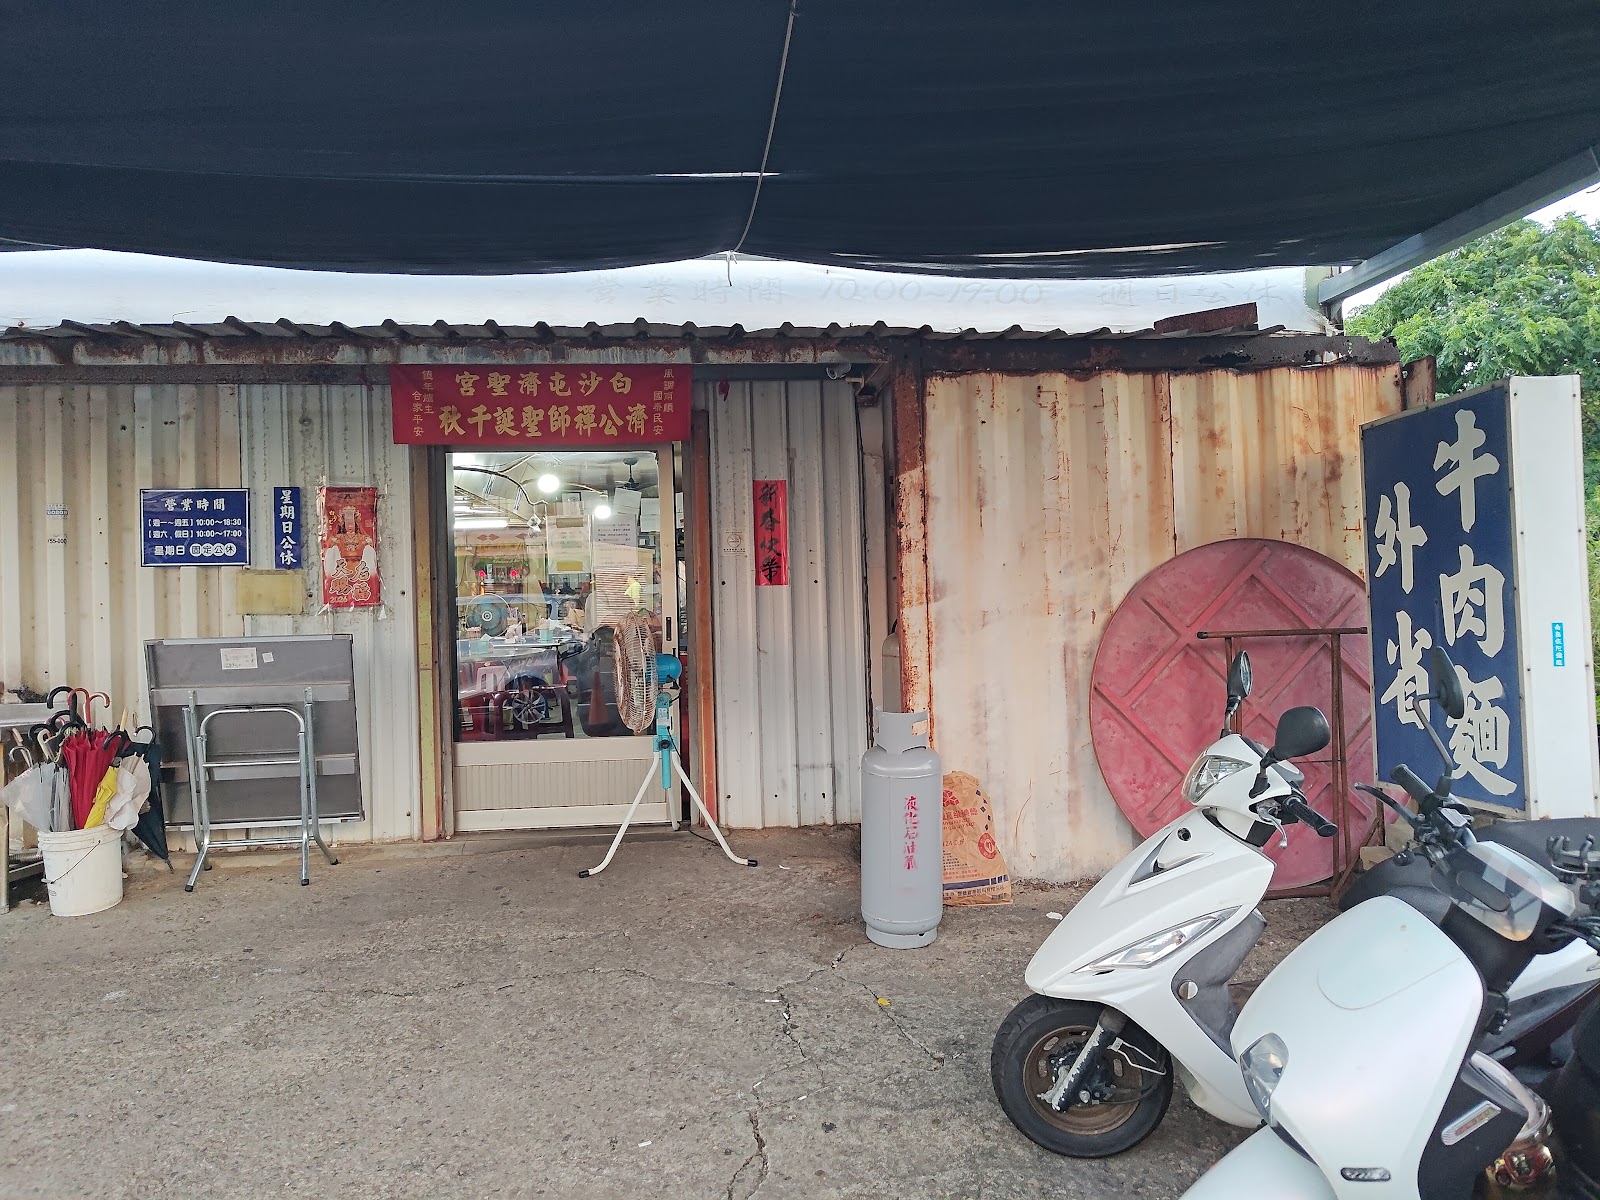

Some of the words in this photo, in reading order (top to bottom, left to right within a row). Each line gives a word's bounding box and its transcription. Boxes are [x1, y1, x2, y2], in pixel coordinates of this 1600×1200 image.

[455, 371, 632, 397] 白沙屯濟聖宮
[412, 390, 424, 437] 合家平安
[438, 403, 649, 438] 濟公禪師聖誕千秋
[652, 390, 664, 436] 國泰民安
[164, 498, 226, 512] 營業時間
[279, 489, 298, 566] 星期日公休
[154, 545, 186, 556] 星期日
[1374, 481, 1433, 730] 外省
[1432, 408, 1517, 796] 牛肉麵
